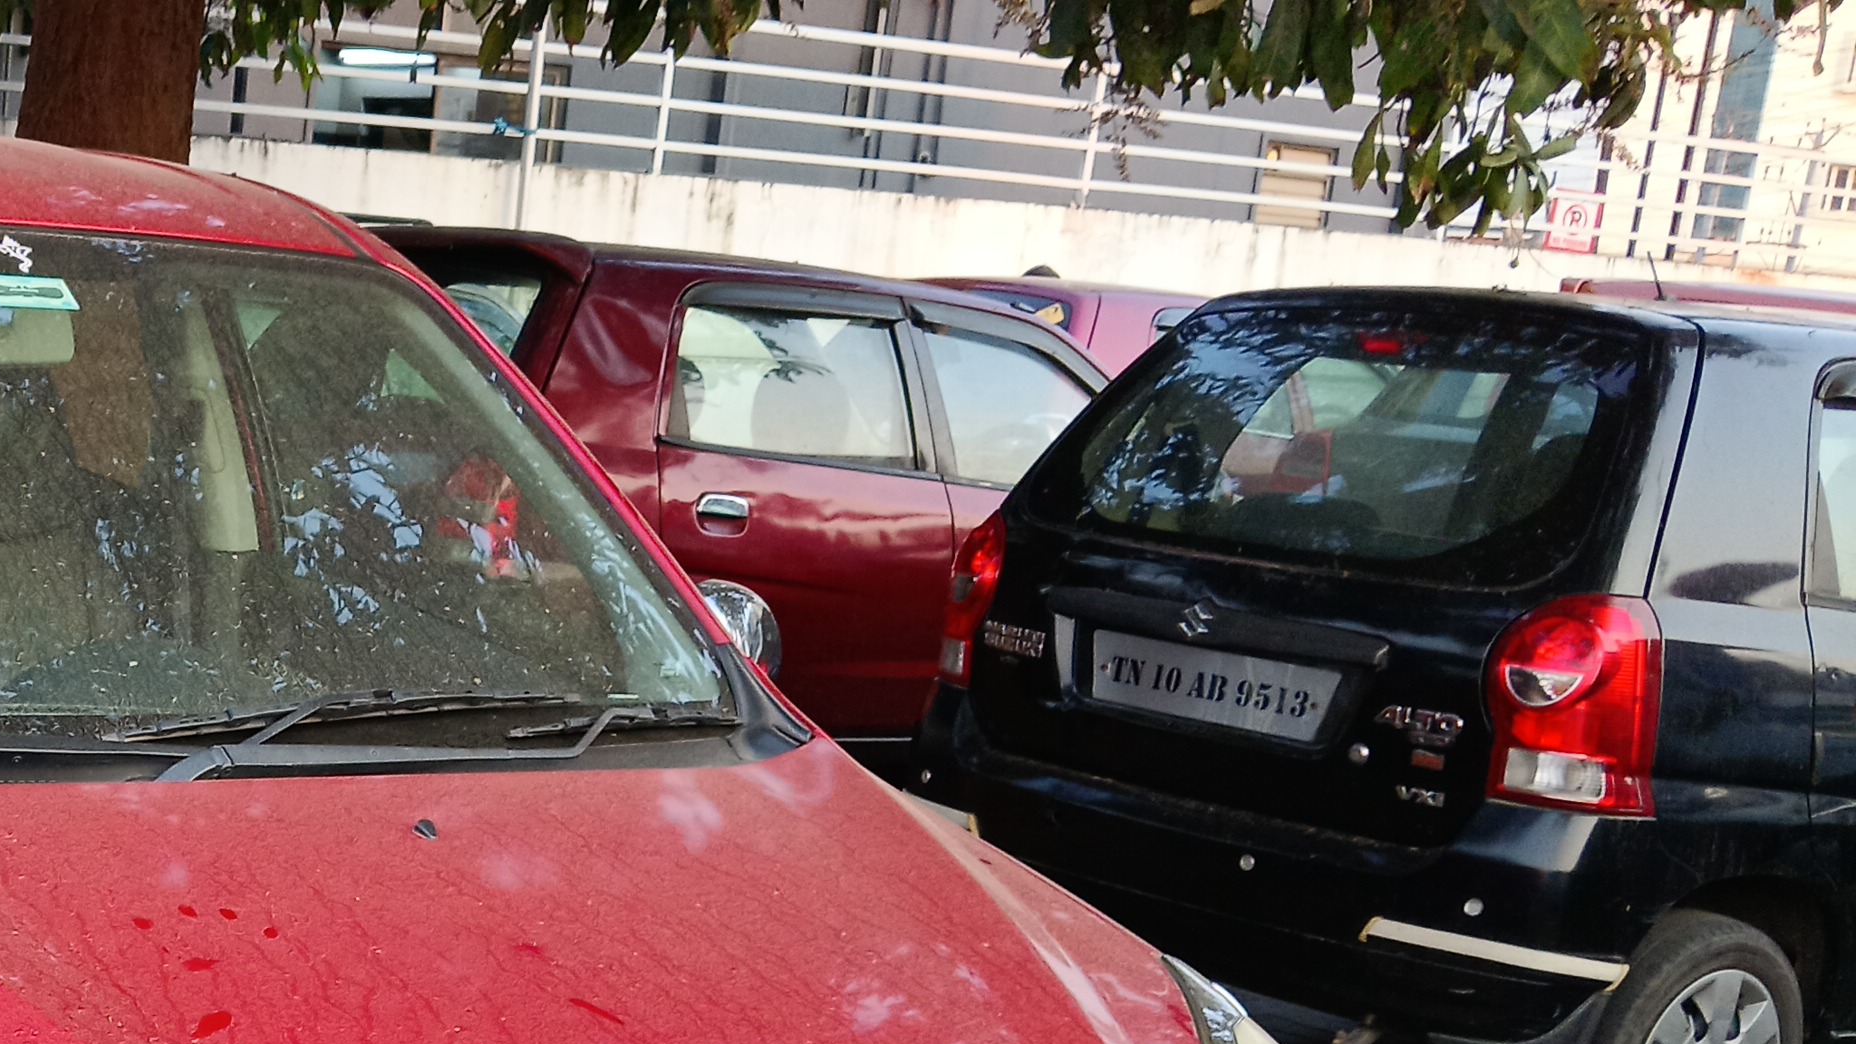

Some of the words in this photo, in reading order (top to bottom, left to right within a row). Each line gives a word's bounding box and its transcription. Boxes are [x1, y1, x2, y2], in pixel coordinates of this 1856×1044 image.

[1111, 656, 1146, 686] TN
[1152, 664, 1182, 693] 10
[1186, 671, 1228, 702] AB
[1235, 680, 1311, 718] 9513
[1374, 705, 1464, 736] ALTO
